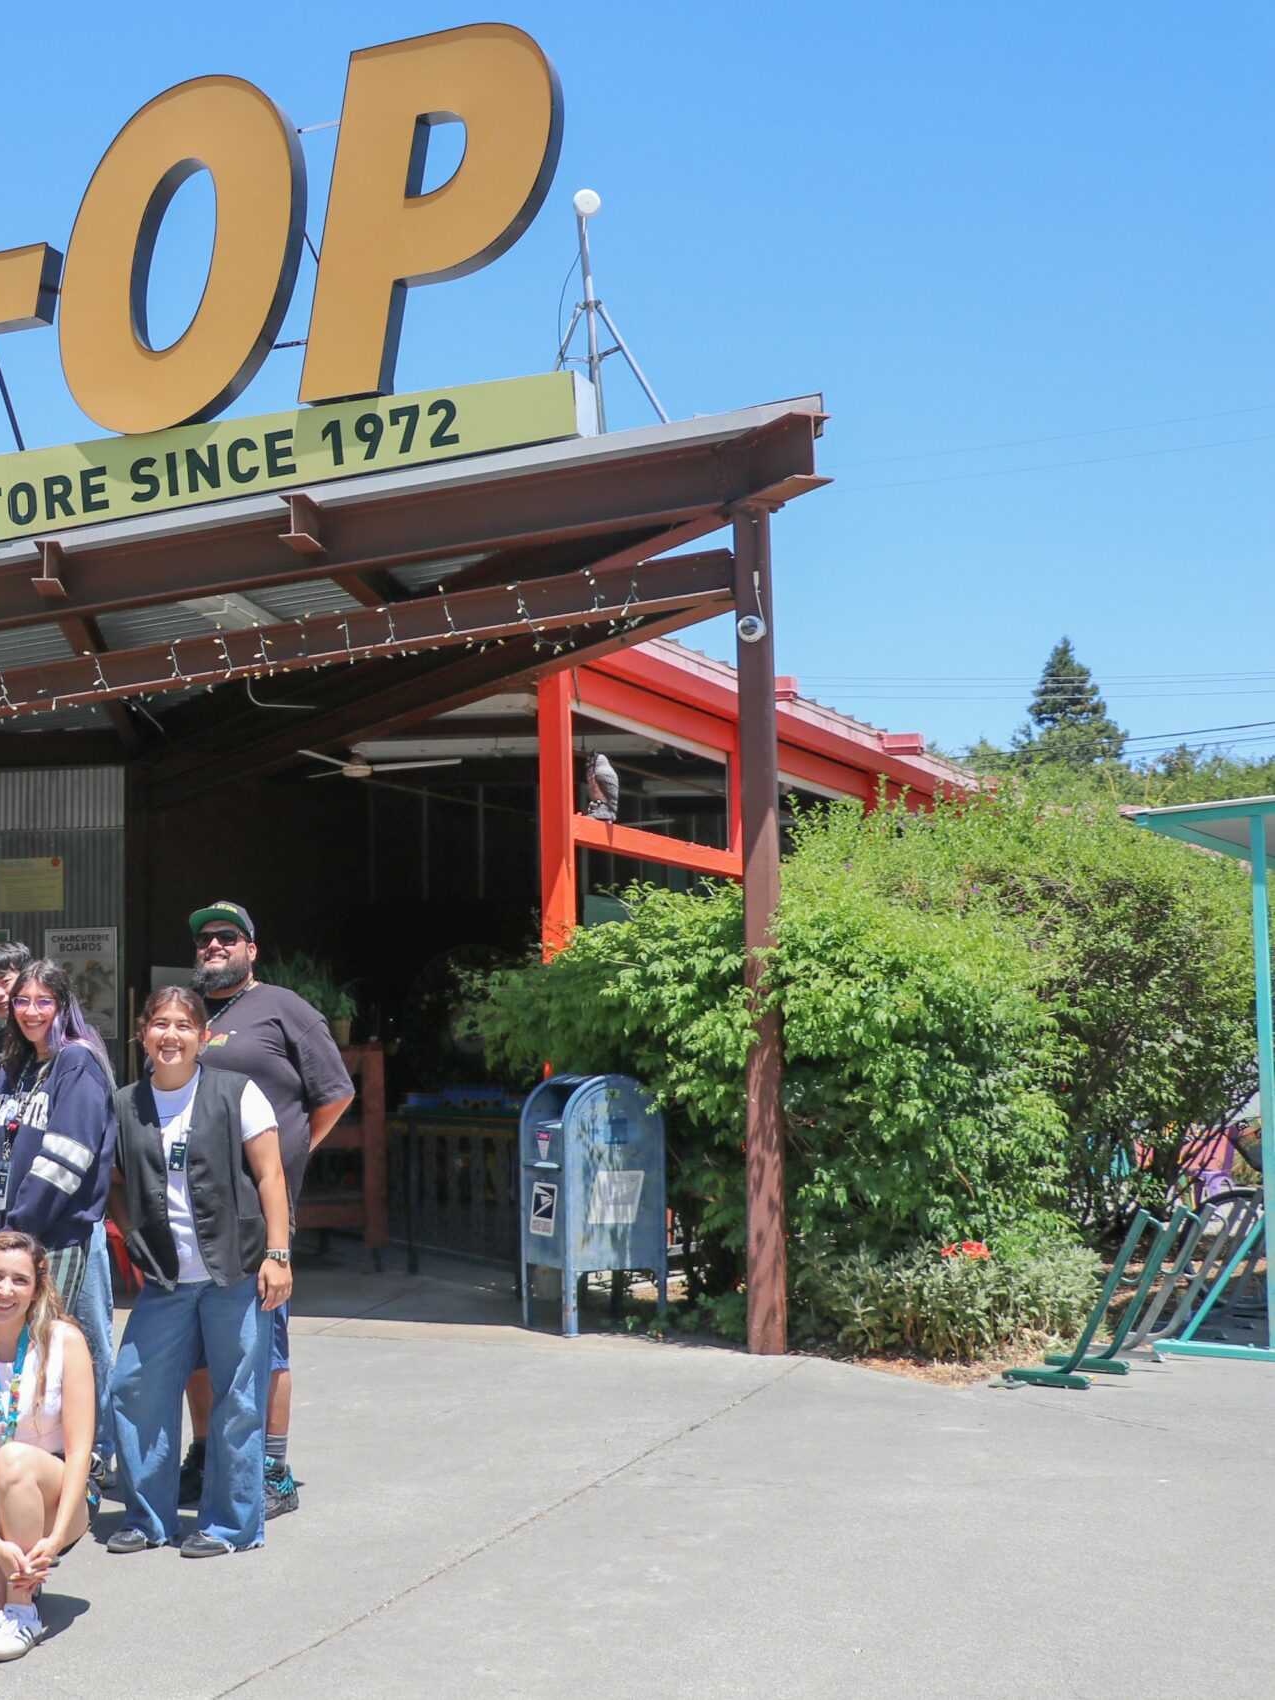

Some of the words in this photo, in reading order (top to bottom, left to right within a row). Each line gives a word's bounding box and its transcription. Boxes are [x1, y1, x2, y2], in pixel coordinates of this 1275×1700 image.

[129, 429, 297, 503] SINCE
[320, 399, 460, 467] 1972
[51, 933, 110, 942] CHARCUTERIE
[59, 942, 103, 953] BOARDS
